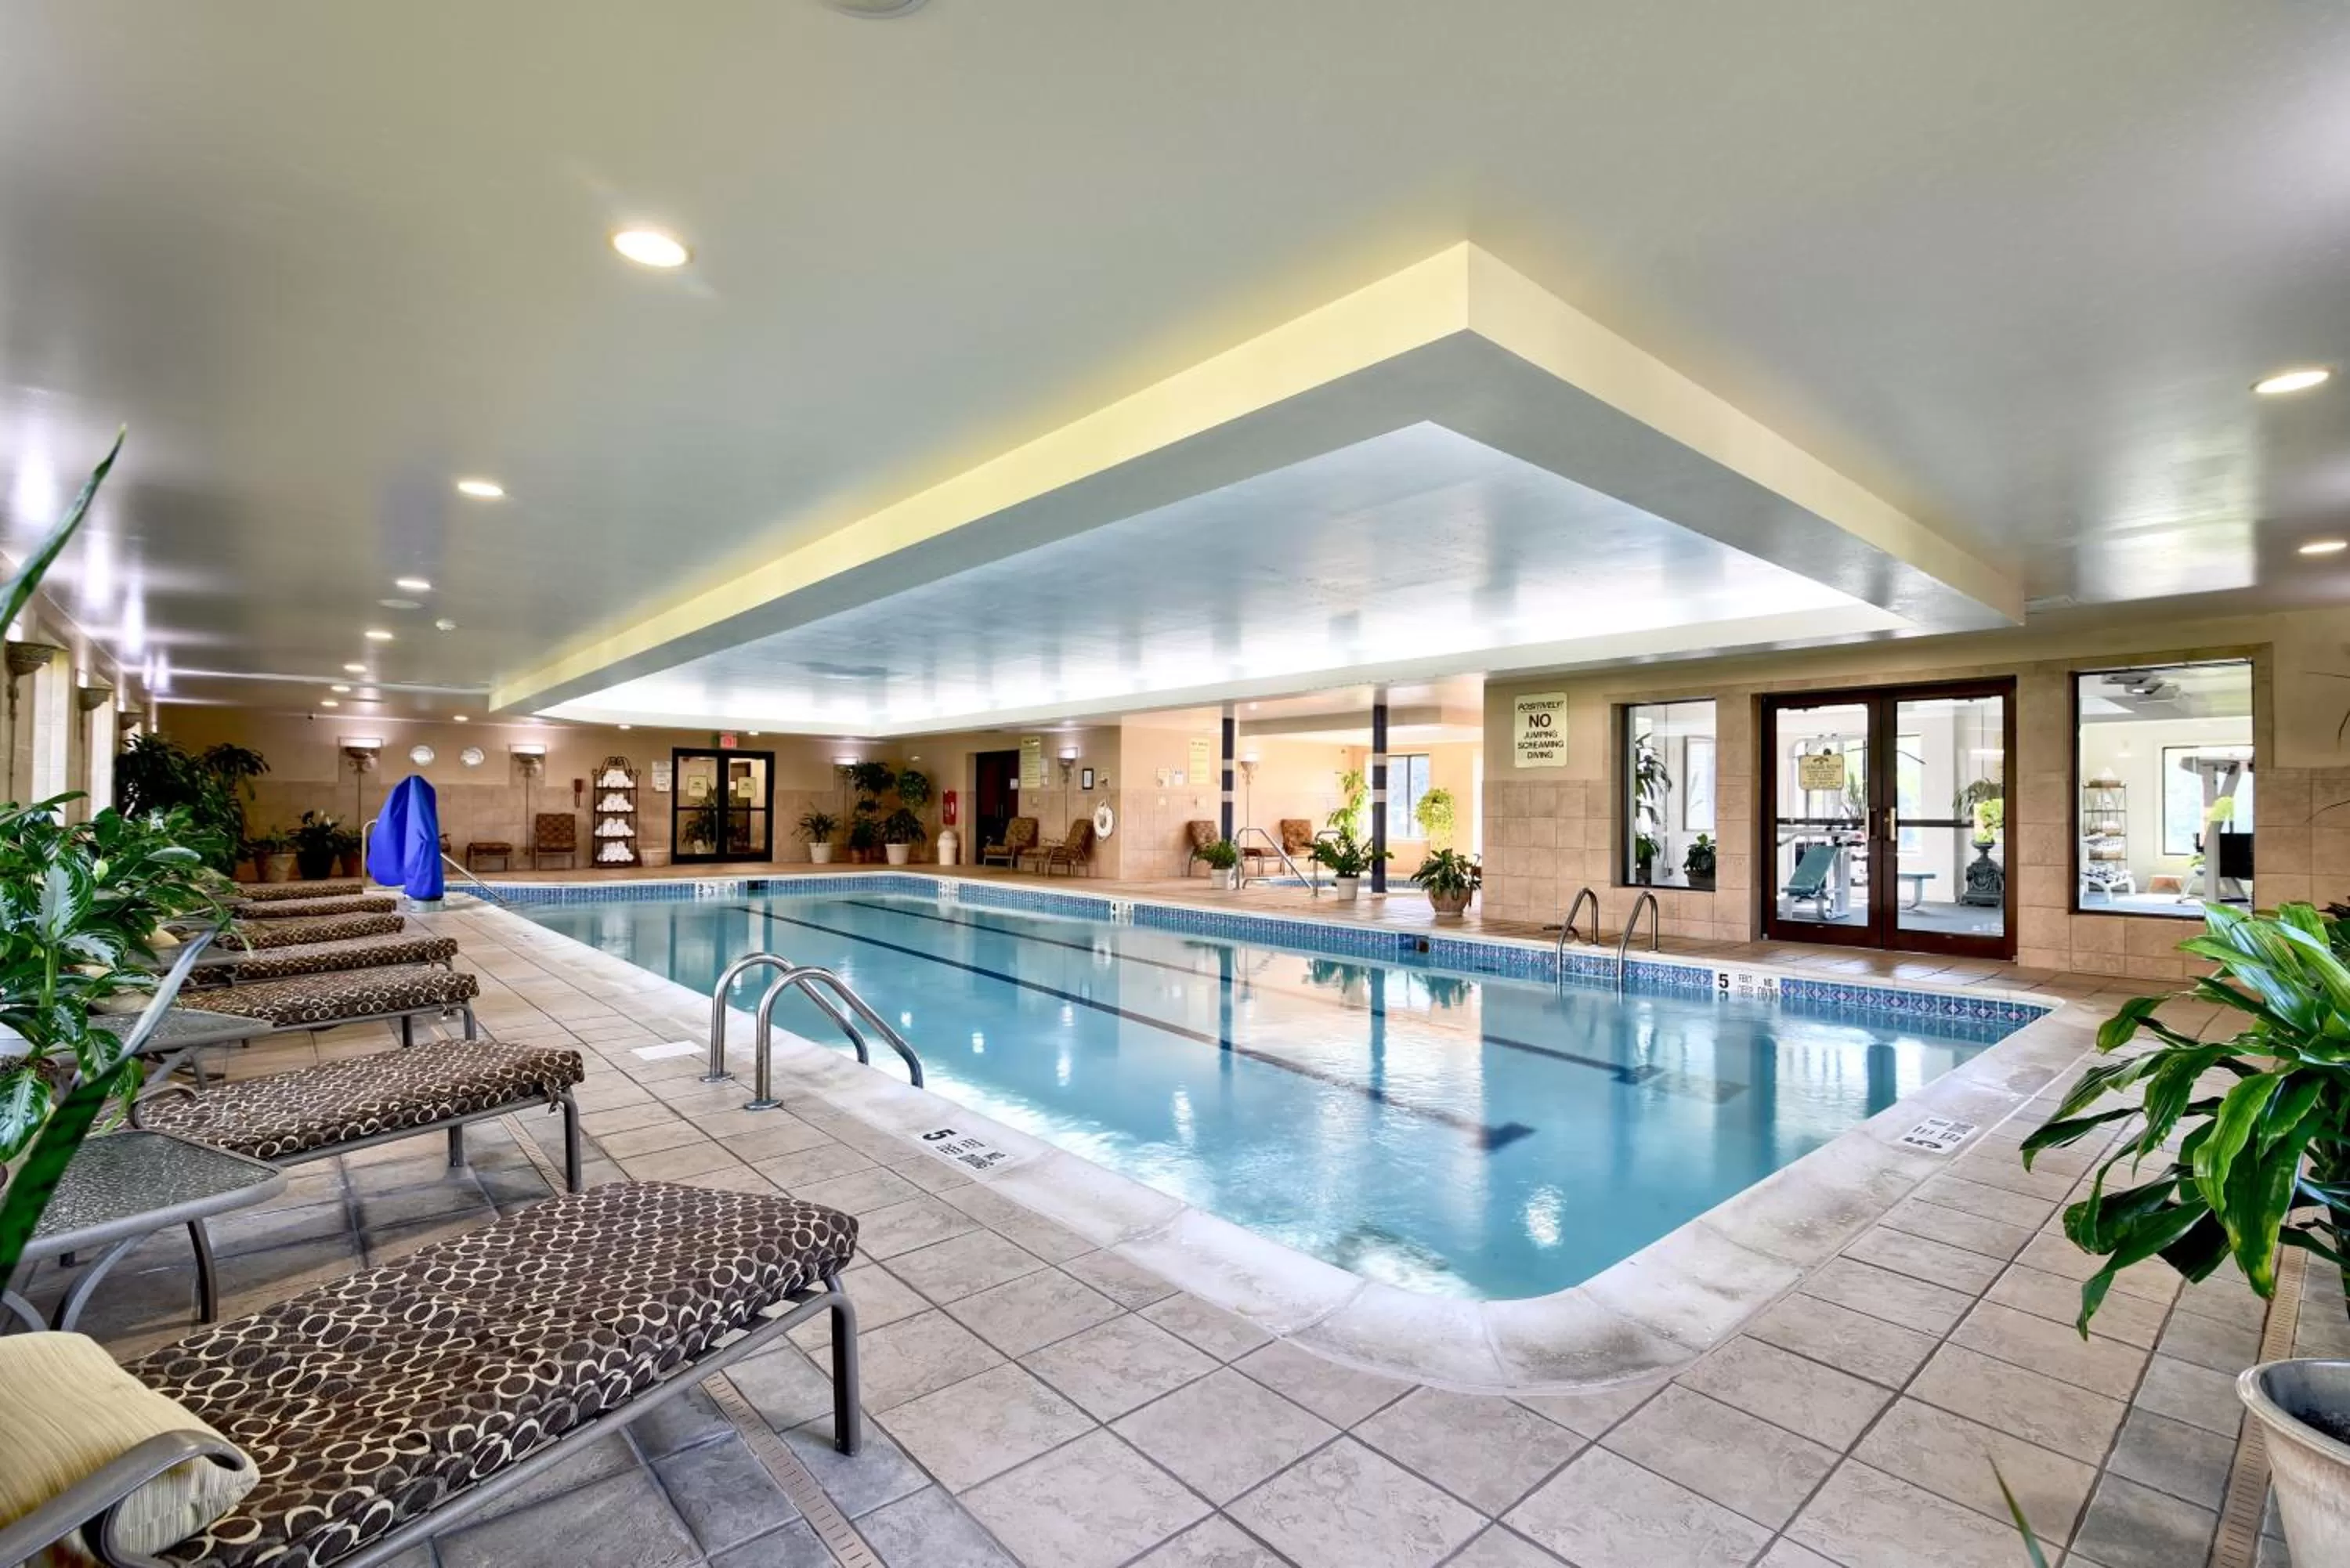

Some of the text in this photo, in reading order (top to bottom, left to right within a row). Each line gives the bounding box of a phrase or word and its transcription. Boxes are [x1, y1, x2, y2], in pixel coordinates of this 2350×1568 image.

[1528, 713, 1552, 728] NO
[1718, 974, 1729, 988] 5
[922, 1129, 957, 1141] 5
